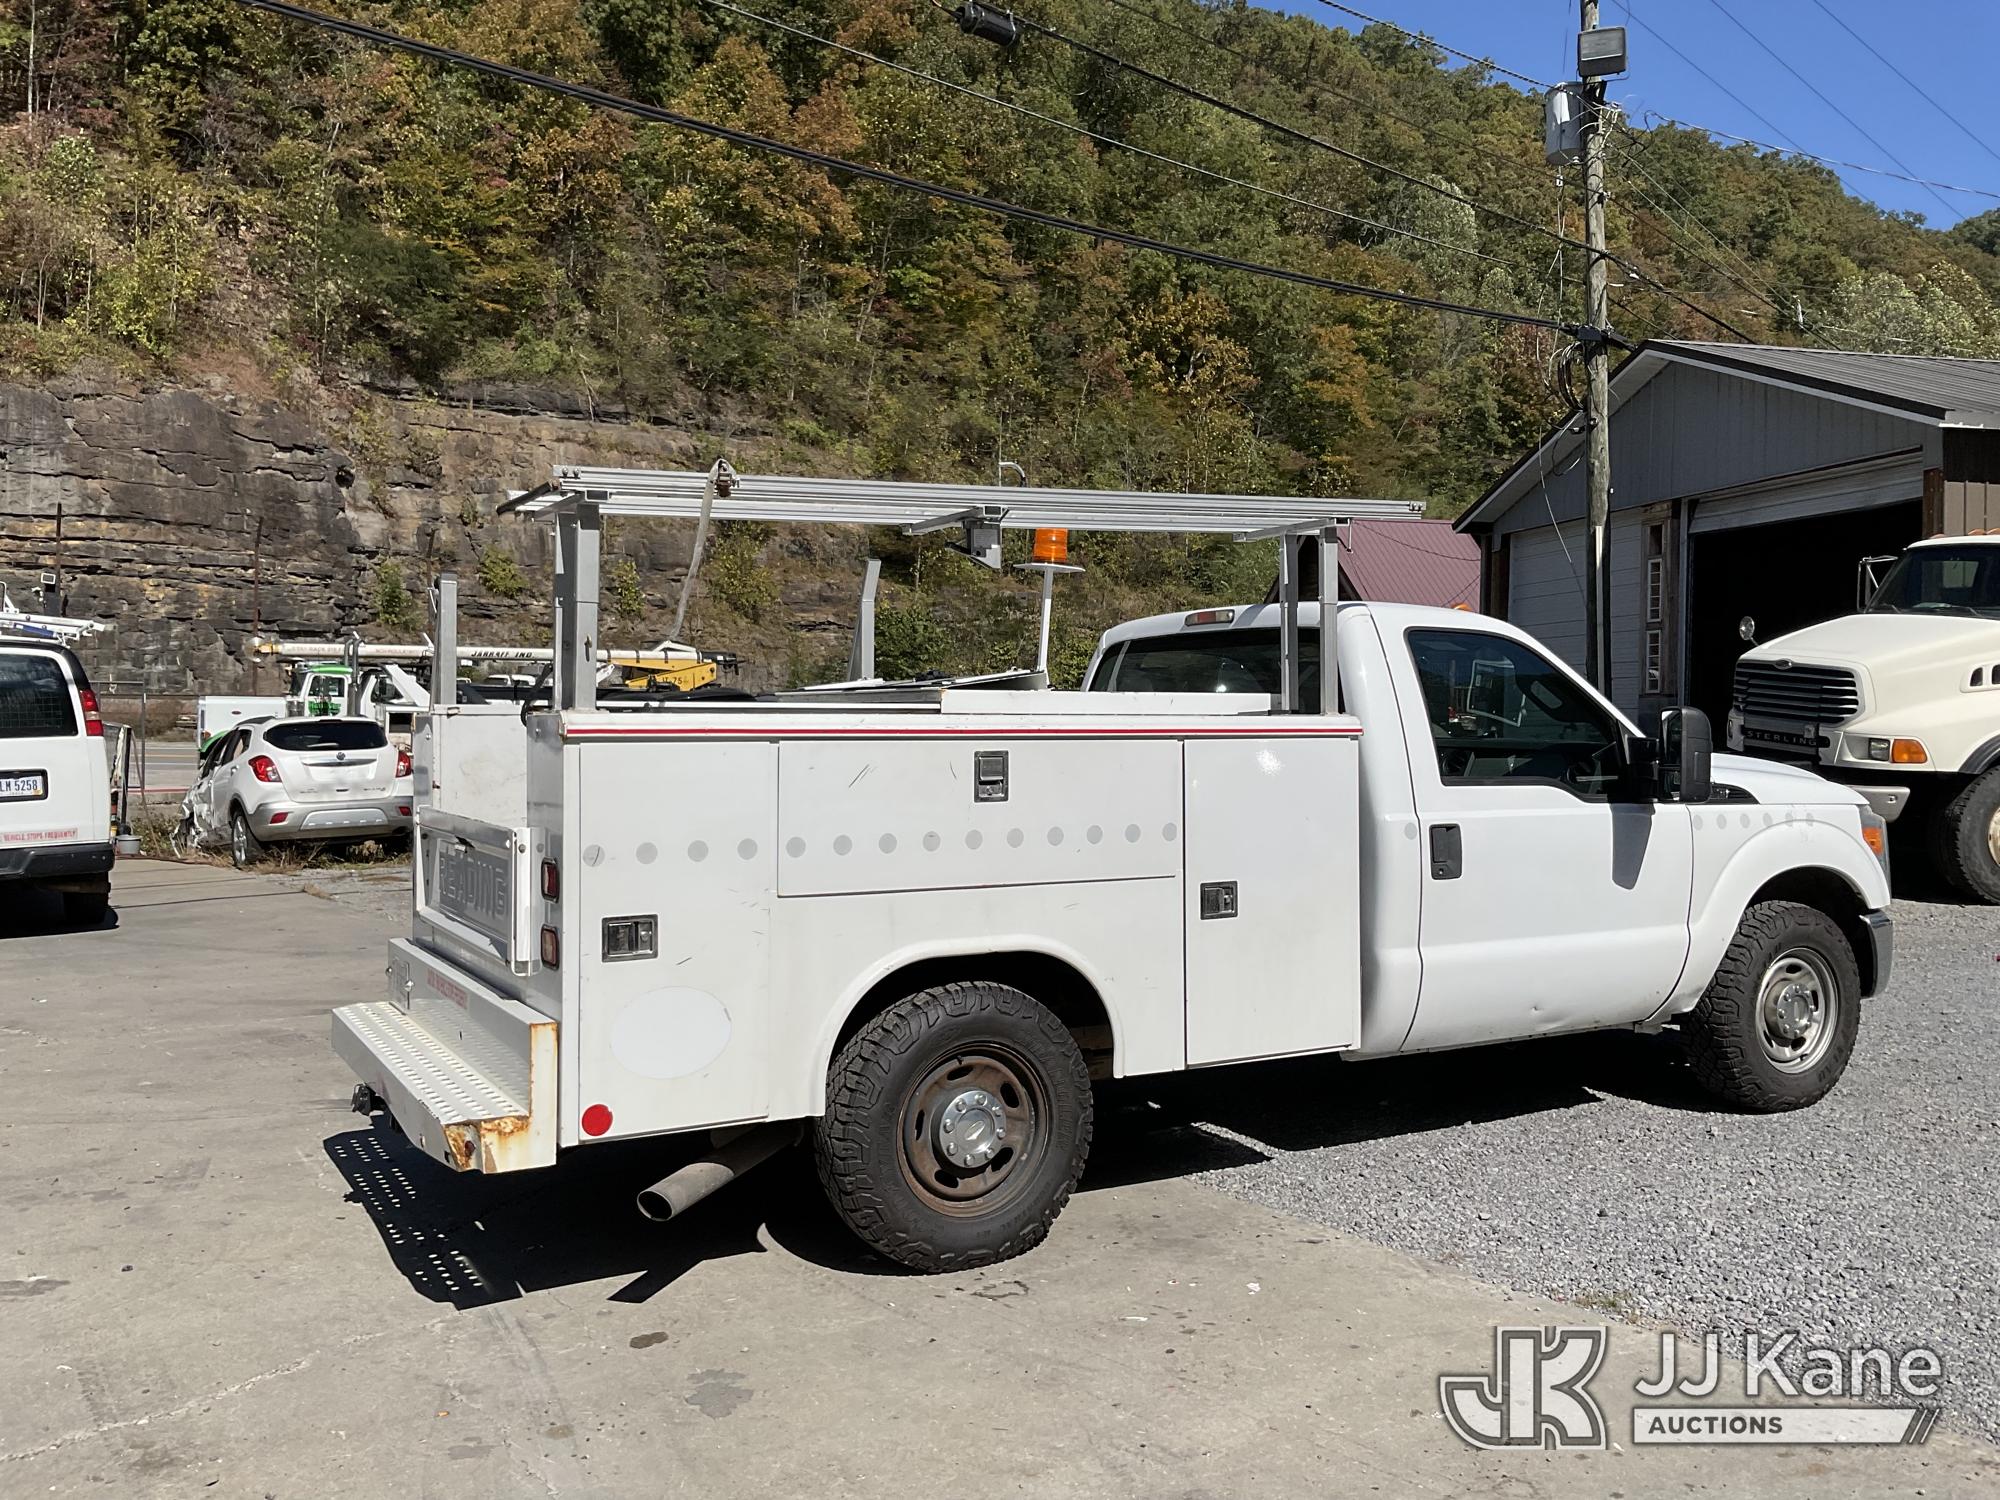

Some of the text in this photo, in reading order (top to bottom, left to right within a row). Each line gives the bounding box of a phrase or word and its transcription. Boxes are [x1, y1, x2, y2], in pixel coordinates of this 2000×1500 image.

[1747, 731, 1816, 745] STERLING
[15, 780, 37, 791] 5258
[440, 854, 506, 917] READING
